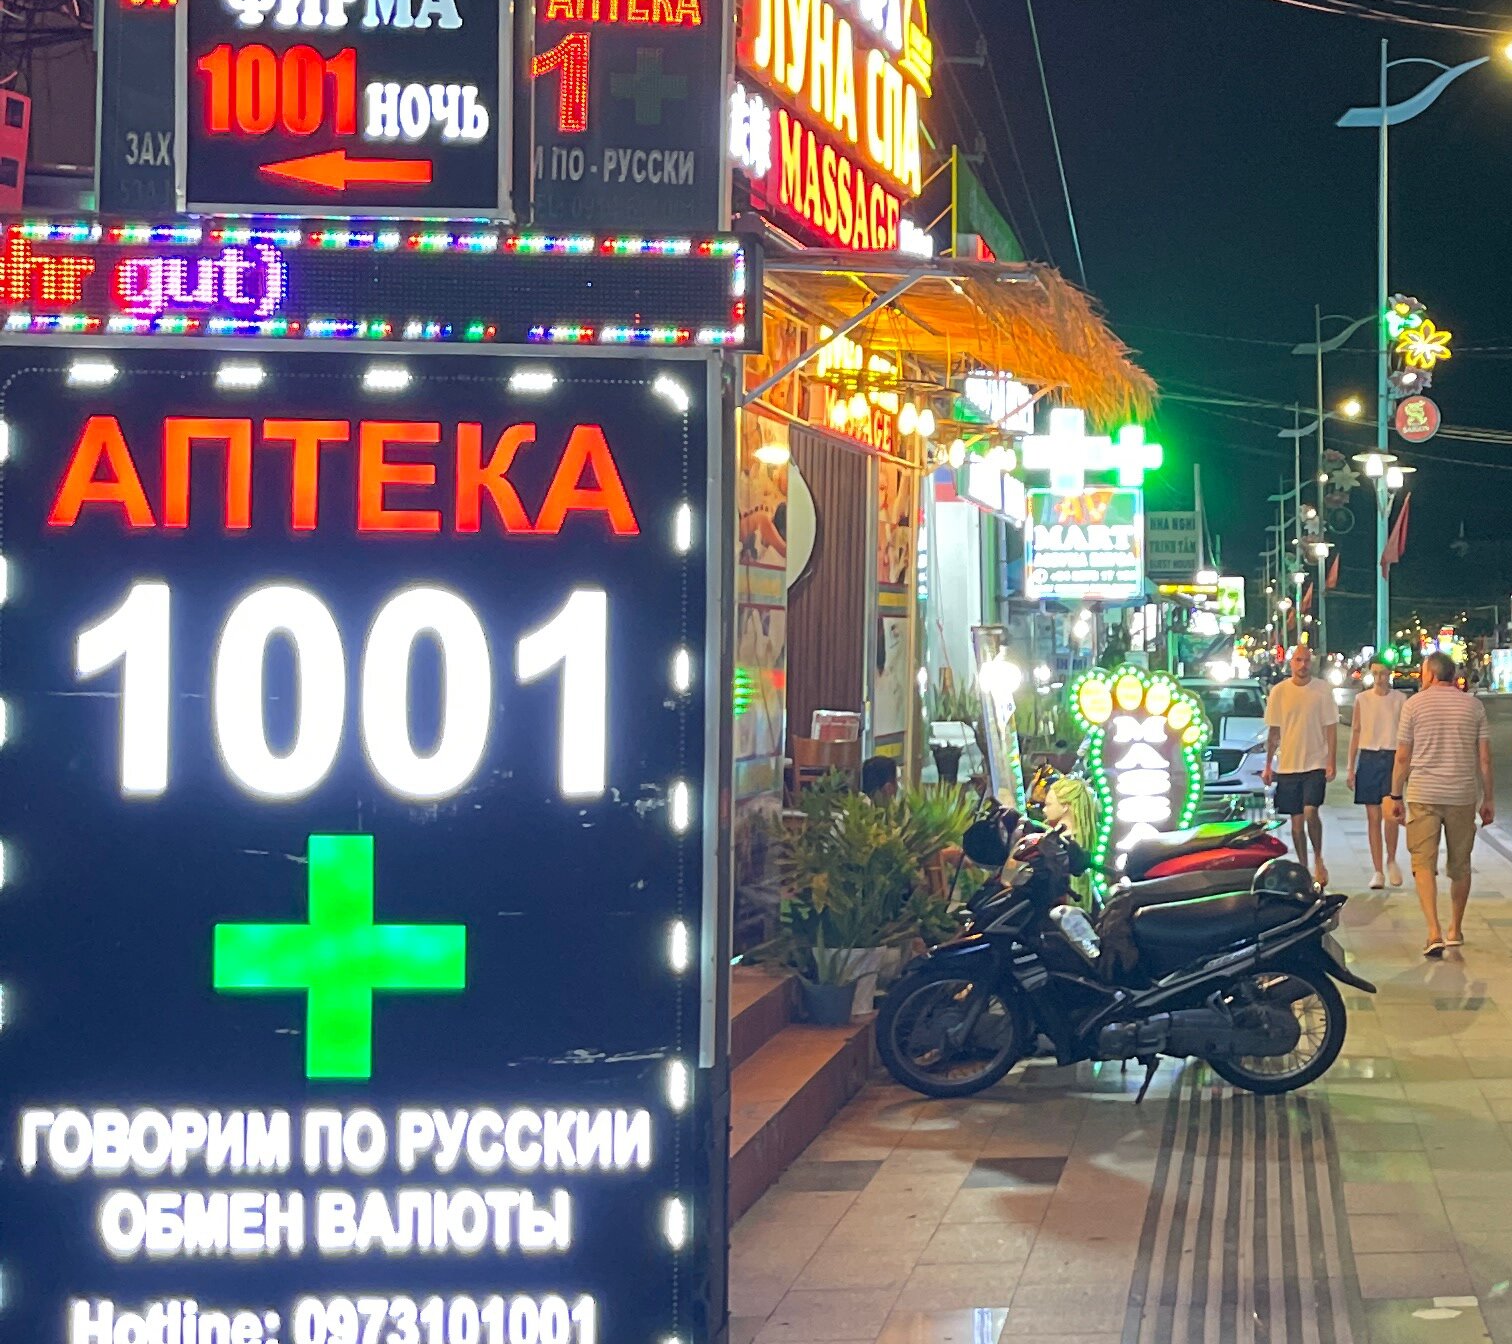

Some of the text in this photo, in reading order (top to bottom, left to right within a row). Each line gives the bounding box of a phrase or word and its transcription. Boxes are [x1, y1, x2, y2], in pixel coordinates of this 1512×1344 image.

[198, 43, 491, 140] 1001 НОЧЬ
[864, 48, 922, 198] СПА
[551, 146, 584, 181] ПО
[603, 147, 694, 185] РУССКИ
[777, 107, 900, 252] MASSAGE
[0, 238, 289, 316] hr gut)
[47, 415, 641, 536] АПТЕКА
[76, 580, 608, 798] 1001
[22, 1110, 291, 1174] ГОВОРИМ
[305, 1110, 386, 1171] ПО
[101, 1188, 571, 1255] ОБМЕН ВАЛЮТЫ
